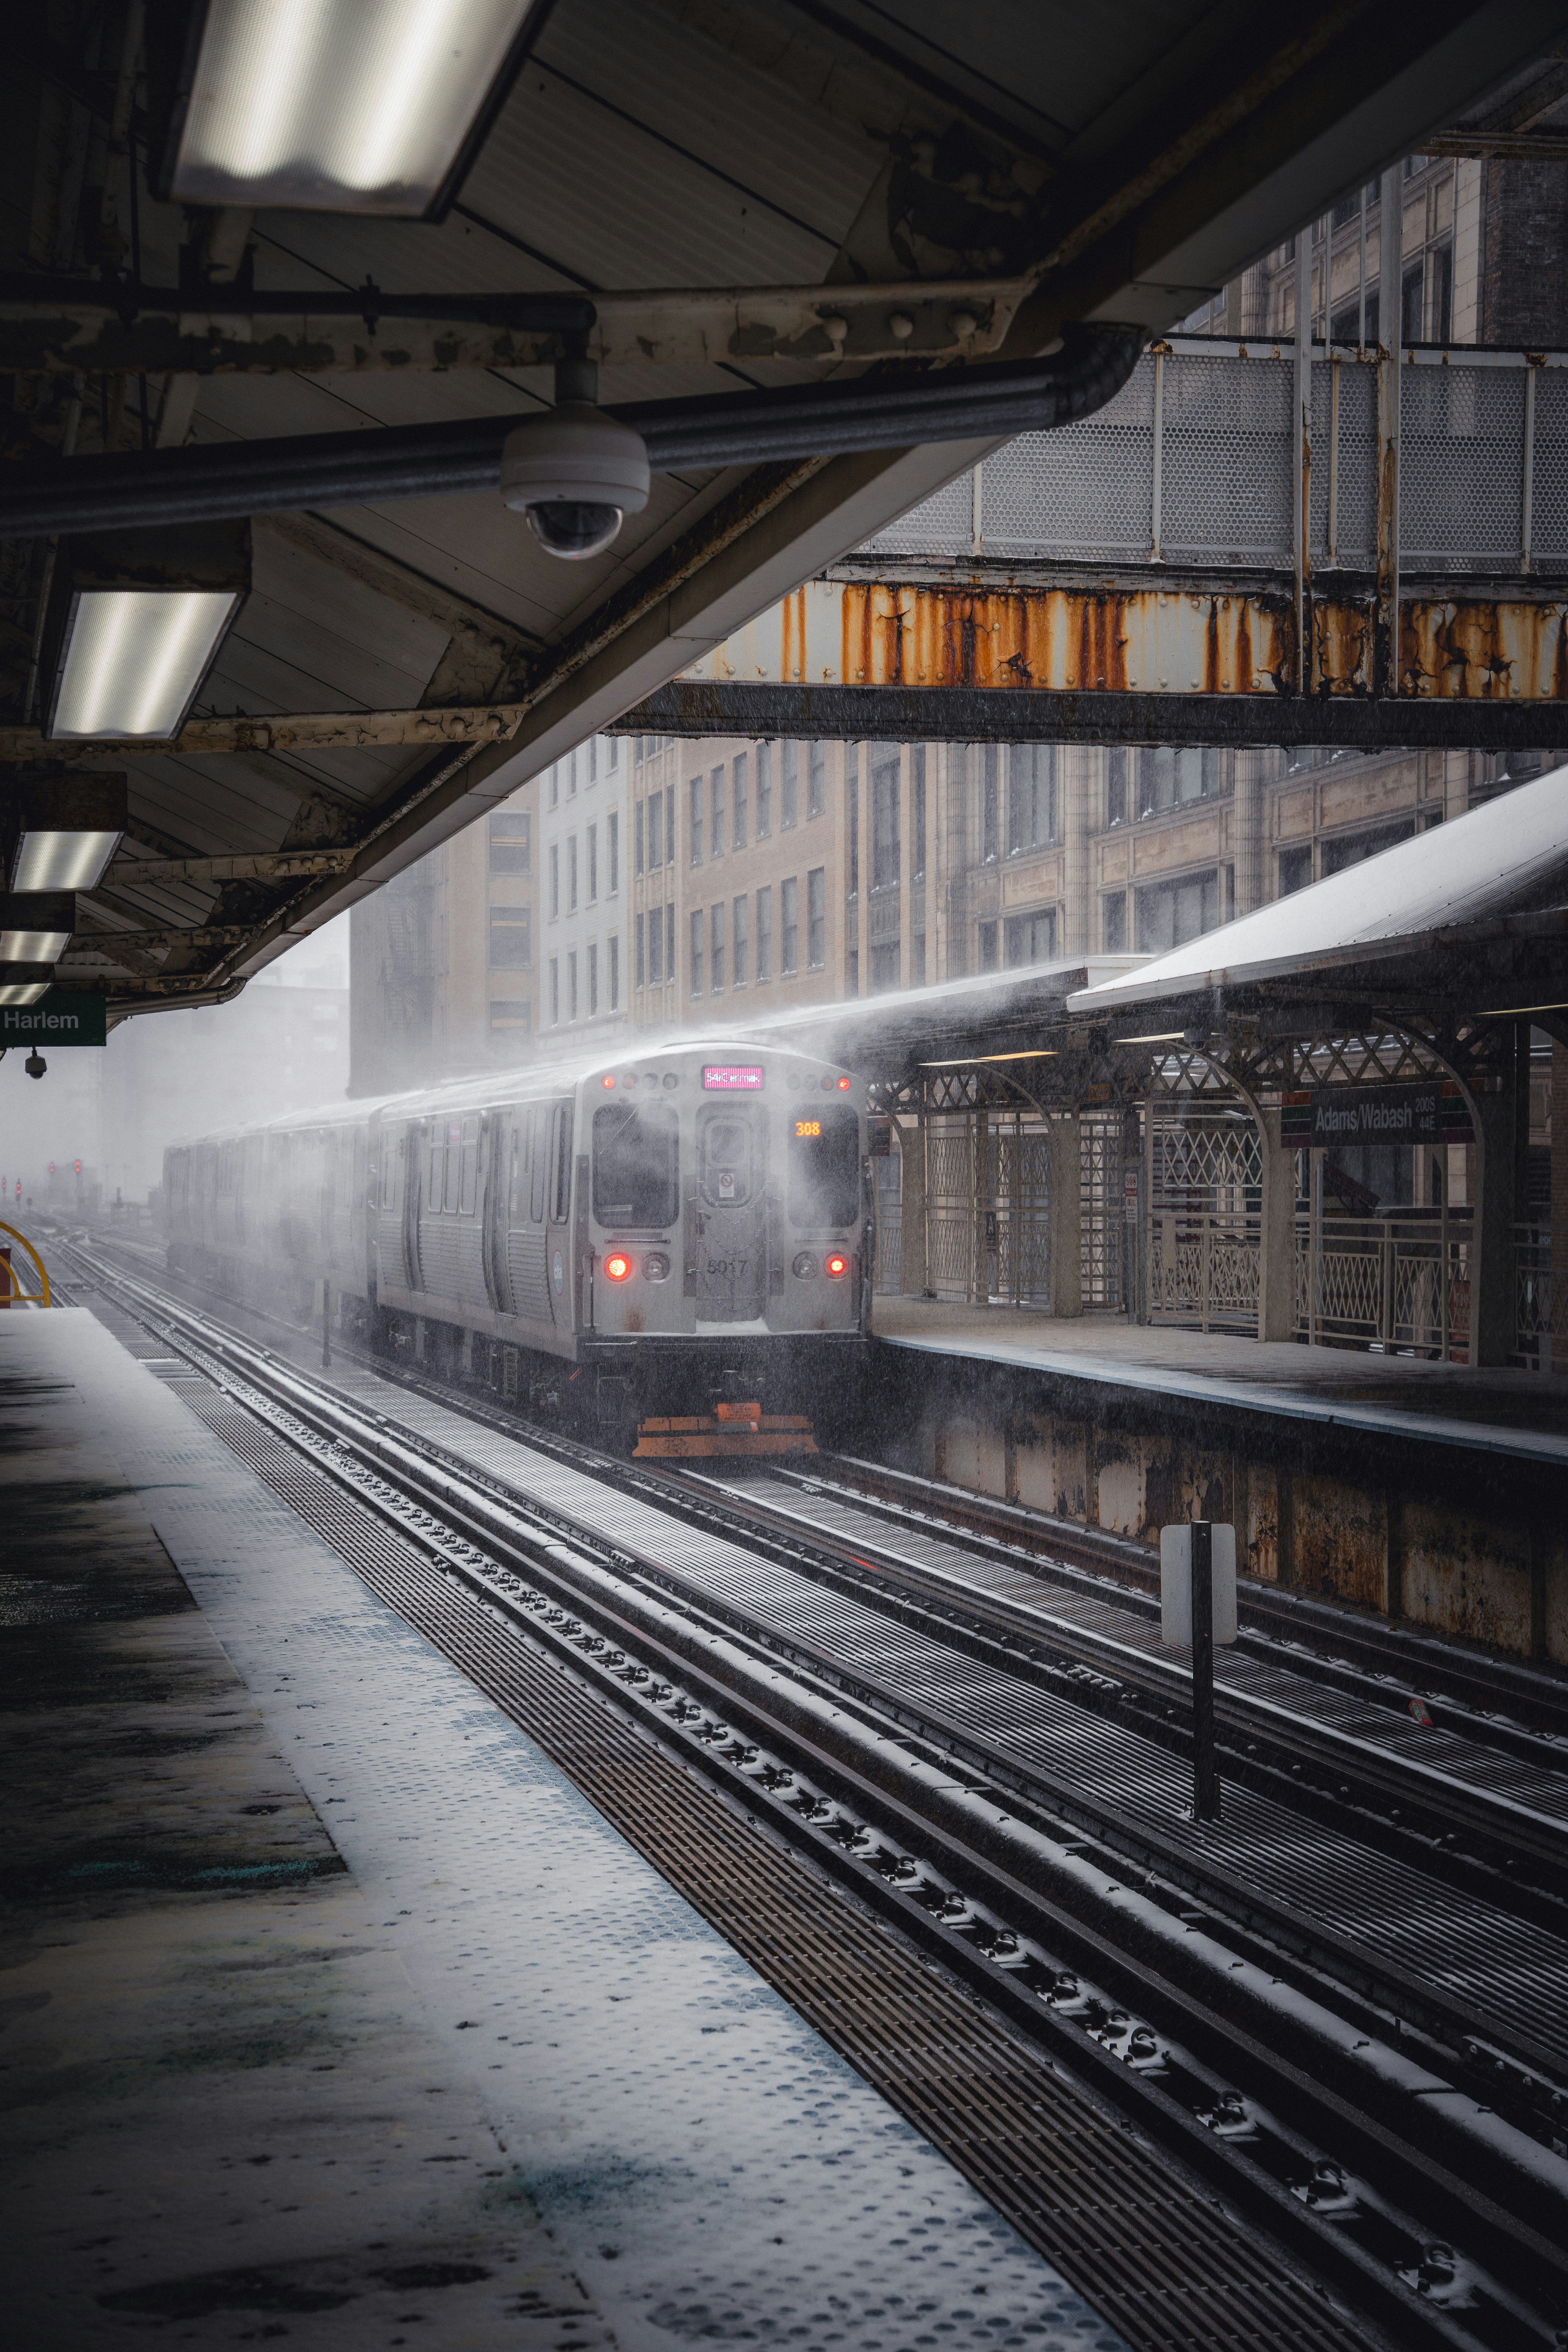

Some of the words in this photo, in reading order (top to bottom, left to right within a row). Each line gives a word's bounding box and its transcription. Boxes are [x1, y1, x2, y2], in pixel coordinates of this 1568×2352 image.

[4, 1011, 79, 1029] Harlem
[1415, 1096, 1436, 1112] 200S
[1315, 1102, 1412, 1132] Adams/Wabash
[1419, 1115, 1436, 1131] 44E
[795, 1122, 821, 1136] 308
[988, 1215, 994, 1234] A
[553, 1264, 562, 1279] cta
[707, 1259, 748, 1275] 5017
